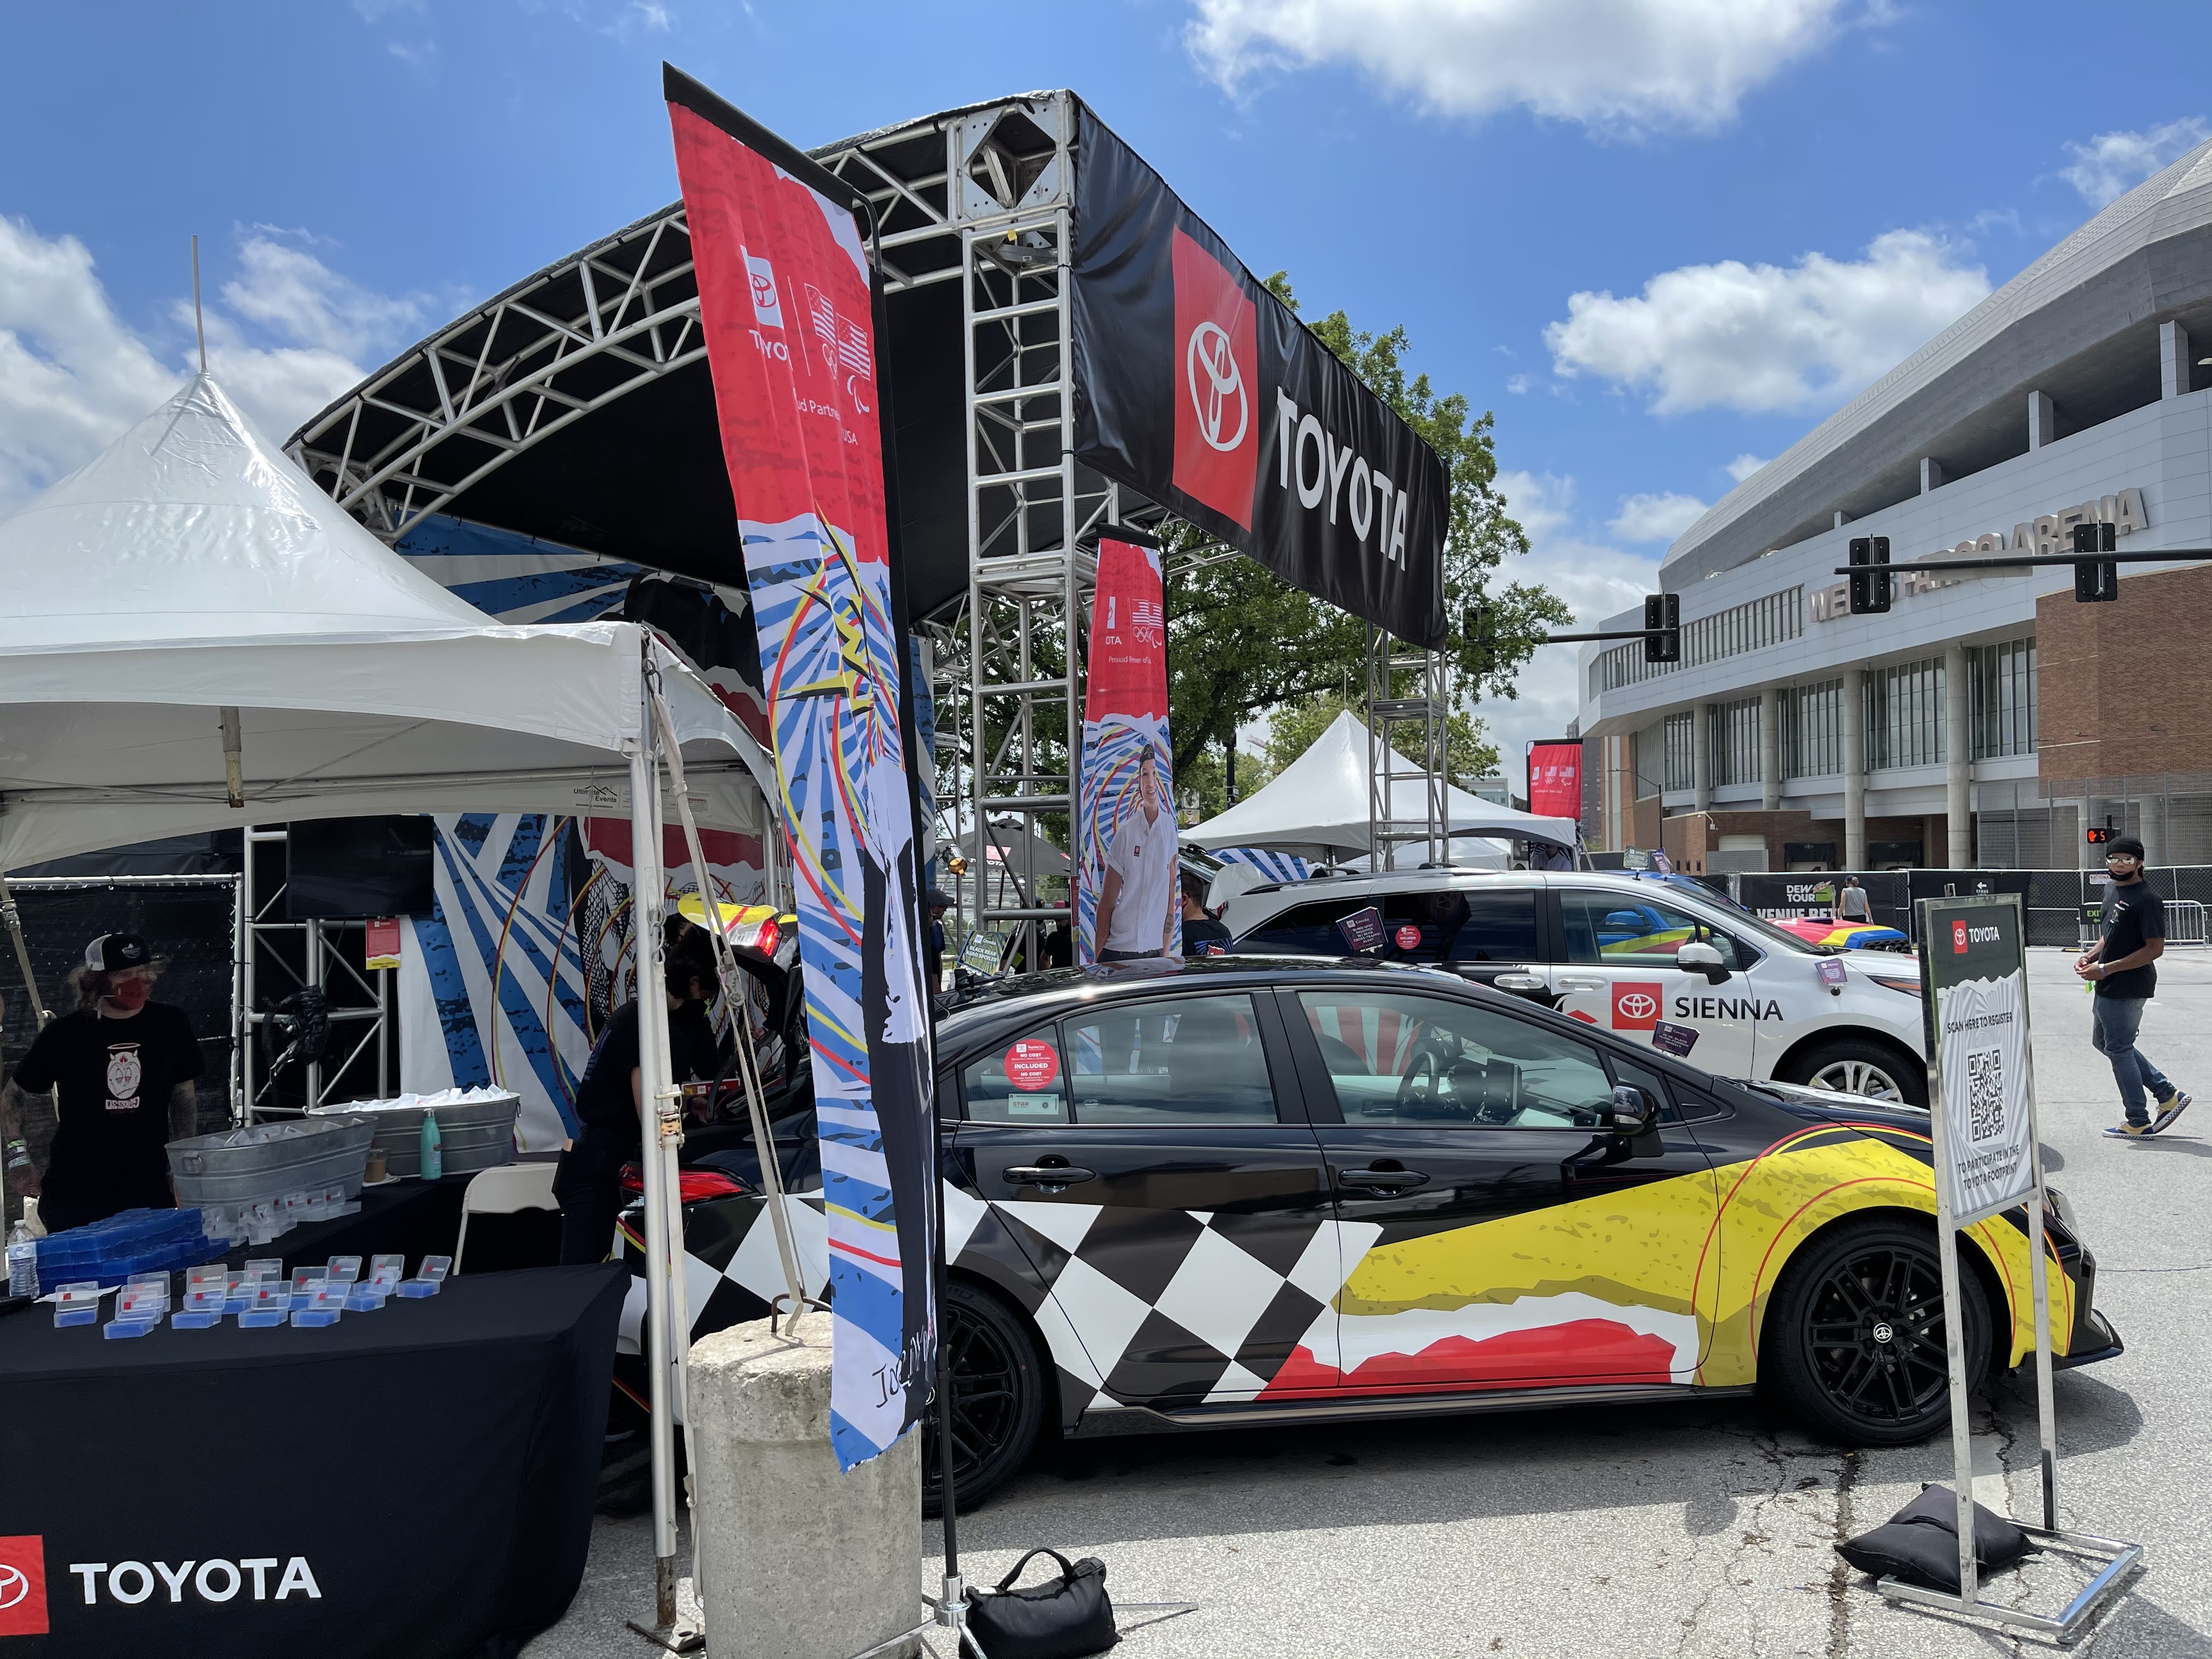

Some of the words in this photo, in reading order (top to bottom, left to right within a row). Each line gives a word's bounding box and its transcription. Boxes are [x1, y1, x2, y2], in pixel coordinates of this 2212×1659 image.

[1277, 386, 1407, 572] TOYOTA
[2100, 831, 2106, 841] 5
[1786, 884, 1813, 894] DEW
[1786, 893, 1816, 902] TOUR
[1968, 927, 2000, 943] TOYOTA
[969, 945, 984, 954] BLACK
[978, 954, 997, 963] SPOILER
[1675, 997, 1784, 1022] SIENNA
[1948, 1020, 1963, 1034] SCAN
[1965, 1018, 1979, 1030] HERE
[1978, 1015, 1988, 1028] TO
[1988, 1012, 2013, 1026] REGISTER
[1957, 1161, 1967, 1175] TO
[1967, 1150, 2002, 1171] PARTICIPATE
[2002, 1148, 2009, 1159] IN
[2009, 1144, 2019, 1158] THE
[1963, 1173, 1987, 1190] TOYOTA
[1988, 1162, 2017, 1181] FOOTPRINT
[69, 1556, 321, 1605] TOYOTA
